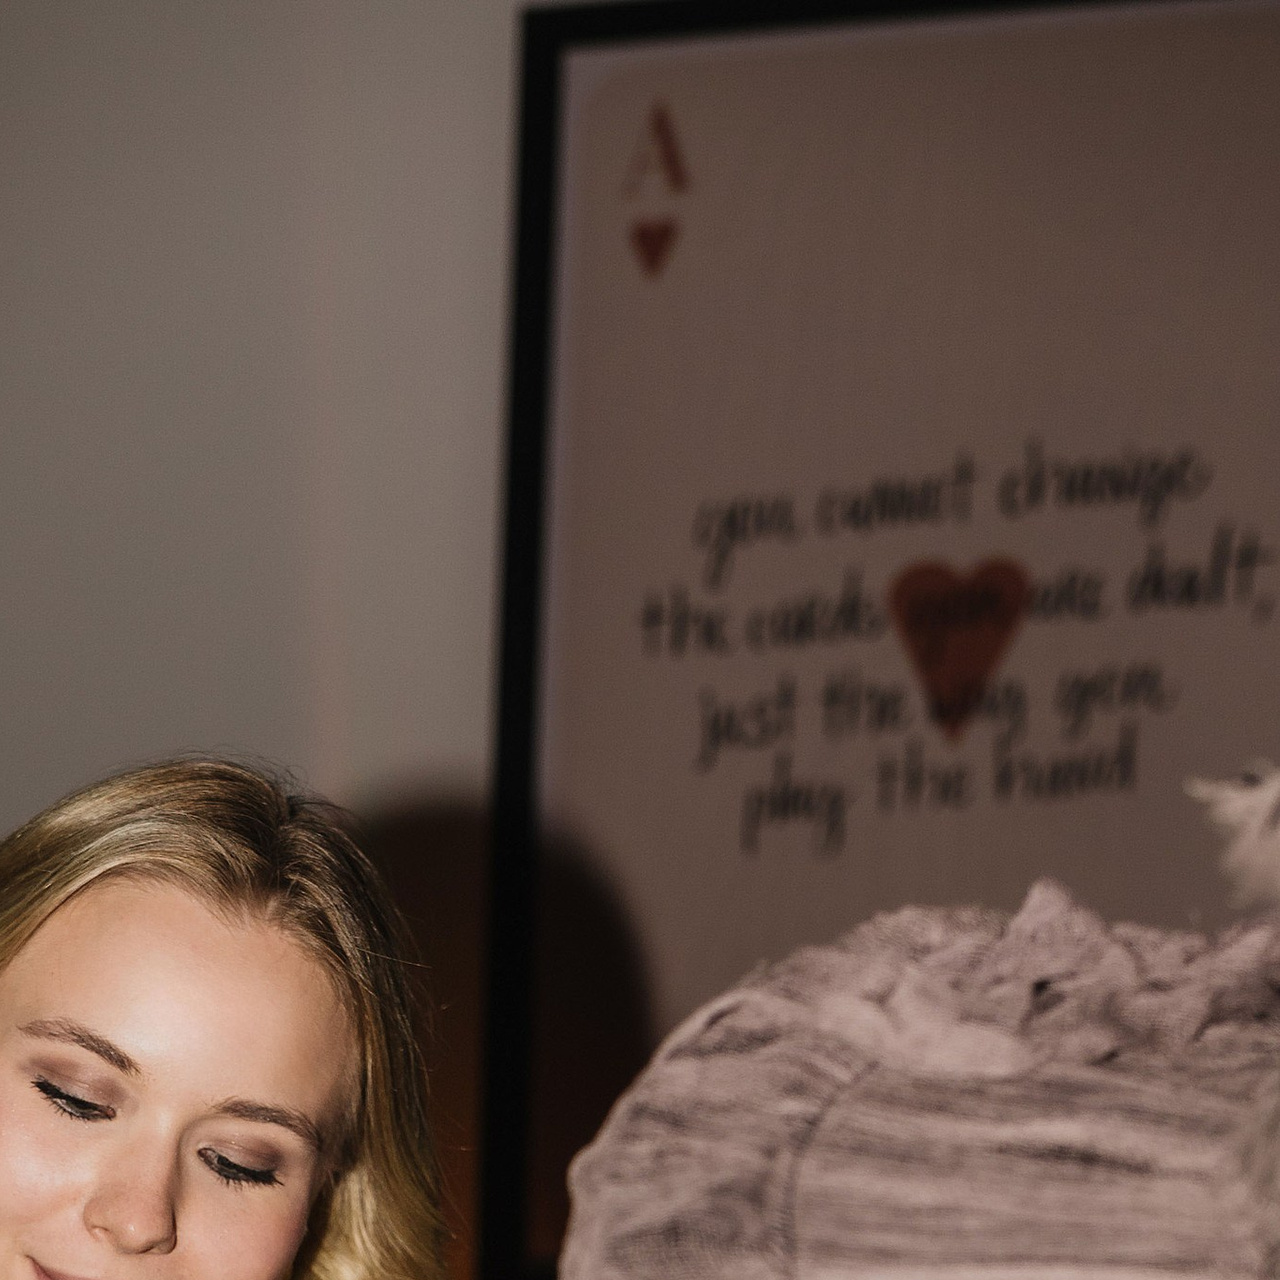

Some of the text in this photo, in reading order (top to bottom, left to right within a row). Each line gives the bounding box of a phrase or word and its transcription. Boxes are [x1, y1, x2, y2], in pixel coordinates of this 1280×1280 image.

[623, 105, 689, 196] A
[641, 588, 727, 654] the
[875, 740, 969, 812] the
